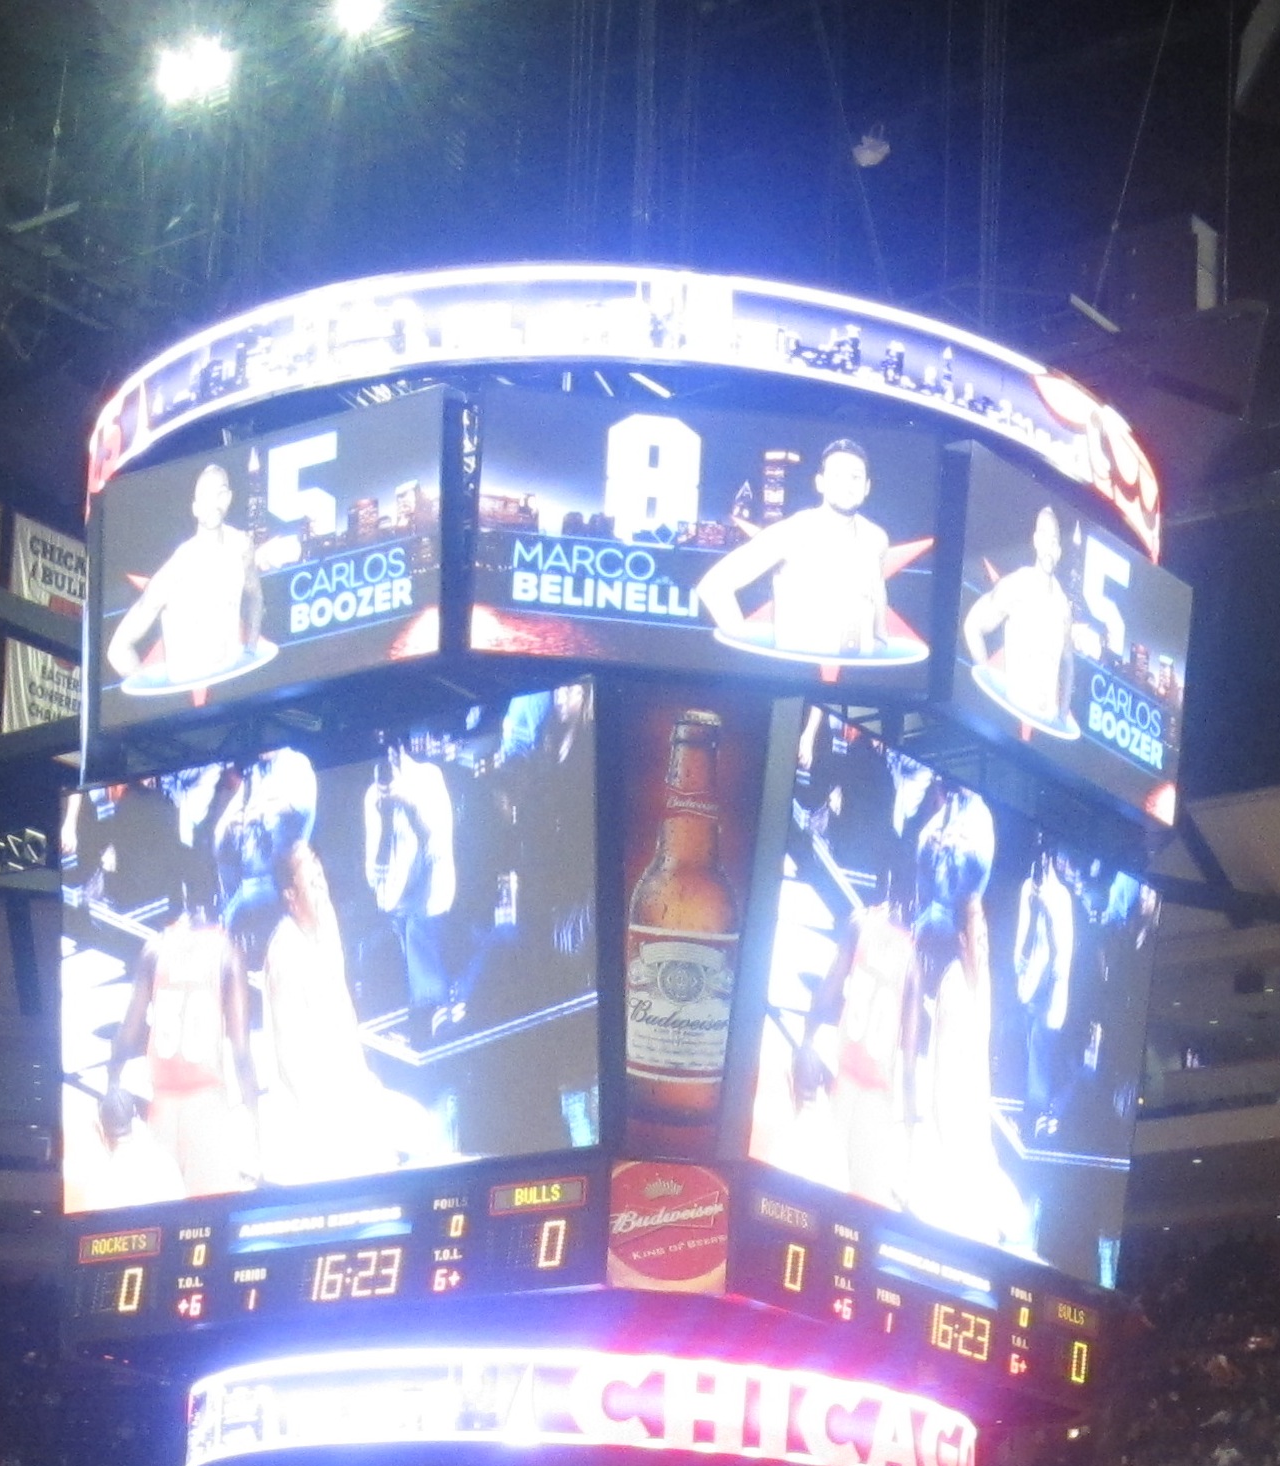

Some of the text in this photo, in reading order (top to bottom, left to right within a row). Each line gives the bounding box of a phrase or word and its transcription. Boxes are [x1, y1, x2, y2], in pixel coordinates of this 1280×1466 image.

[266, 430, 338, 536] 5
[605, 413, 702, 546] 8
[29, 535, 88, 578] CHICA
[289, 545, 407, 602] CARLOS
[512, 540, 657, 580] MARCO
[289, 577, 414, 634] BOOZER
[512, 571, 699, 619] BELINELLI
[1083, 533, 1131, 656] 5
[41, 665, 81, 690] EASTER
[1090, 674, 1164, 738] CARLOS
[1088, 705, 1165, 771] BOOZER
[433, 1197, 468, 1211] FOULS
[514, 1183, 561, 1207] BULLS
[761, 1197, 809, 1229] ROCKETS
[179, 1227, 212, 1240] FOULS
[449, 1214, 465, 1237] 0
[609, 1200, 725, 1235] Budweiser
[91, 1234, 147, 1256] ROCKETS
[192, 1245, 206, 1266] 0
[537, 1219, 566, 1269] 0
[843, 1246, 855, 1269] 0
[234, 1267, 267, 1283] PERIOD
[312, 1247, 403, 1302] 16:23
[784, 1243, 806, 1292] 0
[118, 1267, 143, 1312] 0
[931, 1303, 992, 1361] 16:23
[1019, 1307, 1030, 1328] 0
[1058, 1303, 1086, 1326] BULLS
[1071, 1340, 1088, 1384] 0
